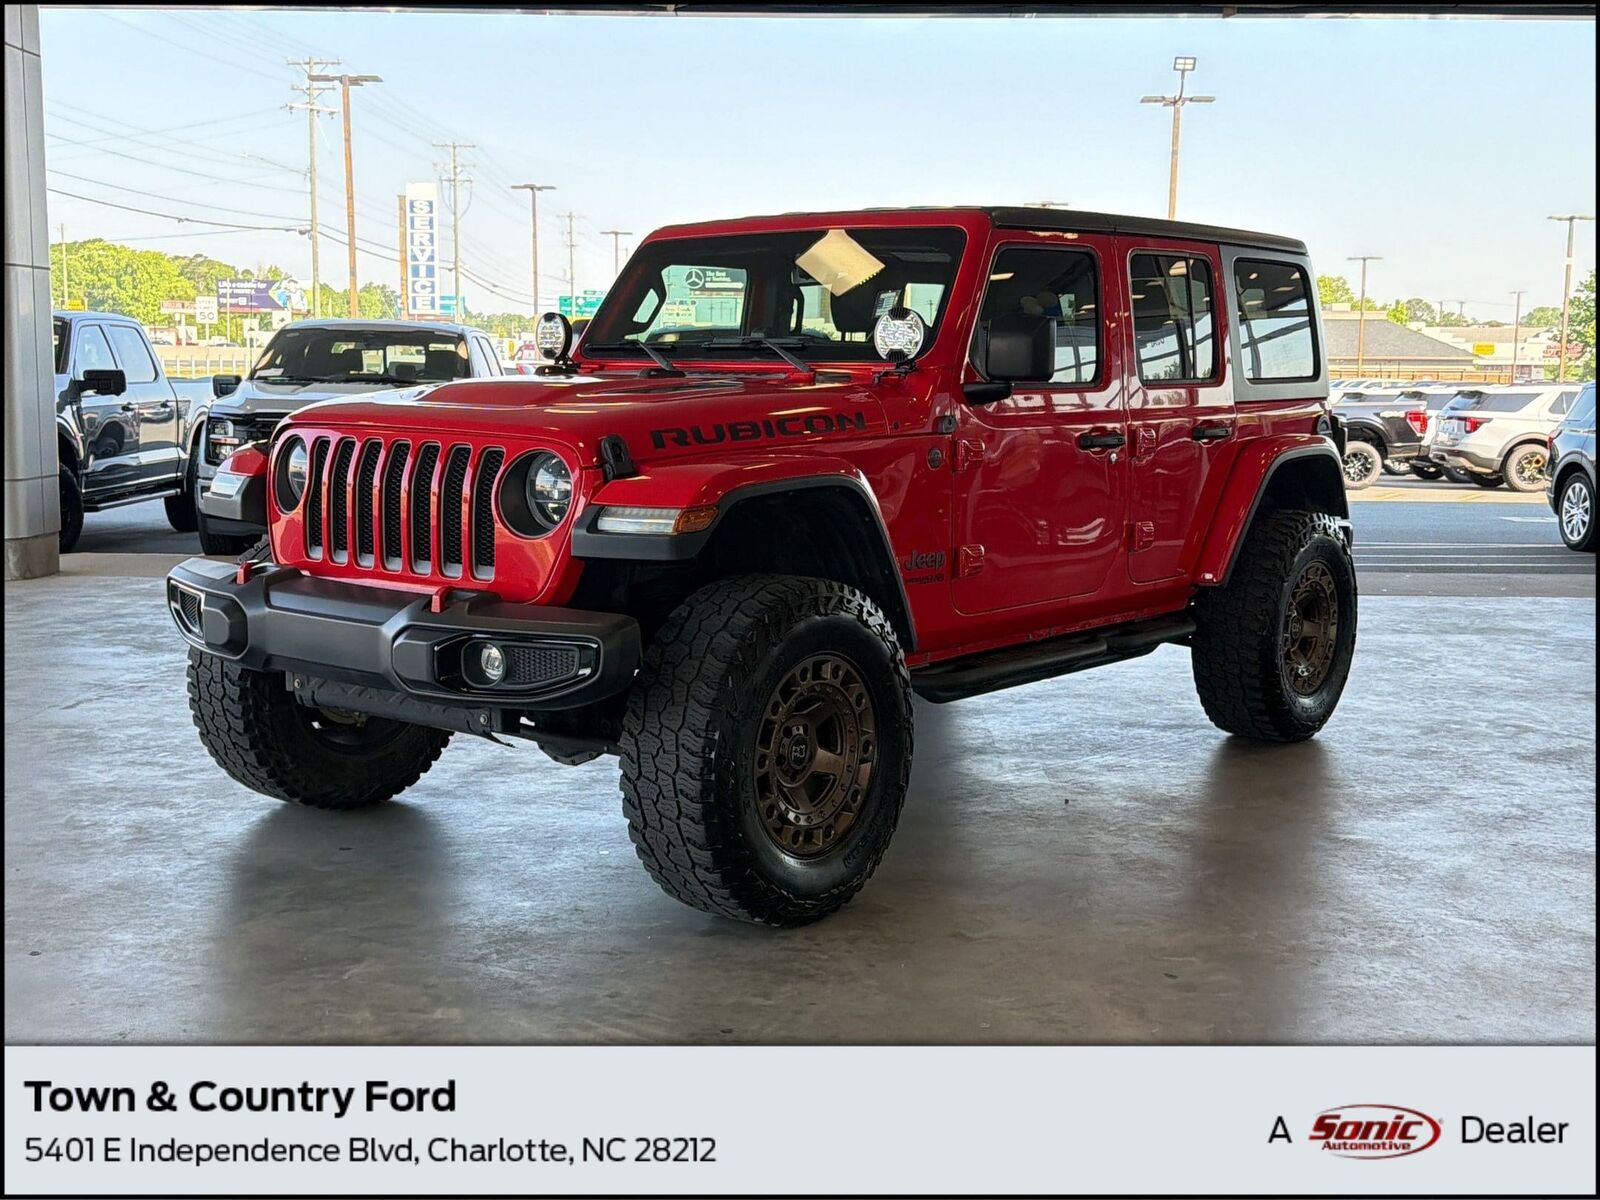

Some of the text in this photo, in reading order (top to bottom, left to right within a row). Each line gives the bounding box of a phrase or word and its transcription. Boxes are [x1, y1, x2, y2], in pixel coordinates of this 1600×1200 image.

[412, 199, 433, 310] SERVICE
[199, 311, 215, 321] 50
[650, 411, 866, 449] RUBICON
[904, 550, 946, 571] Jeep
